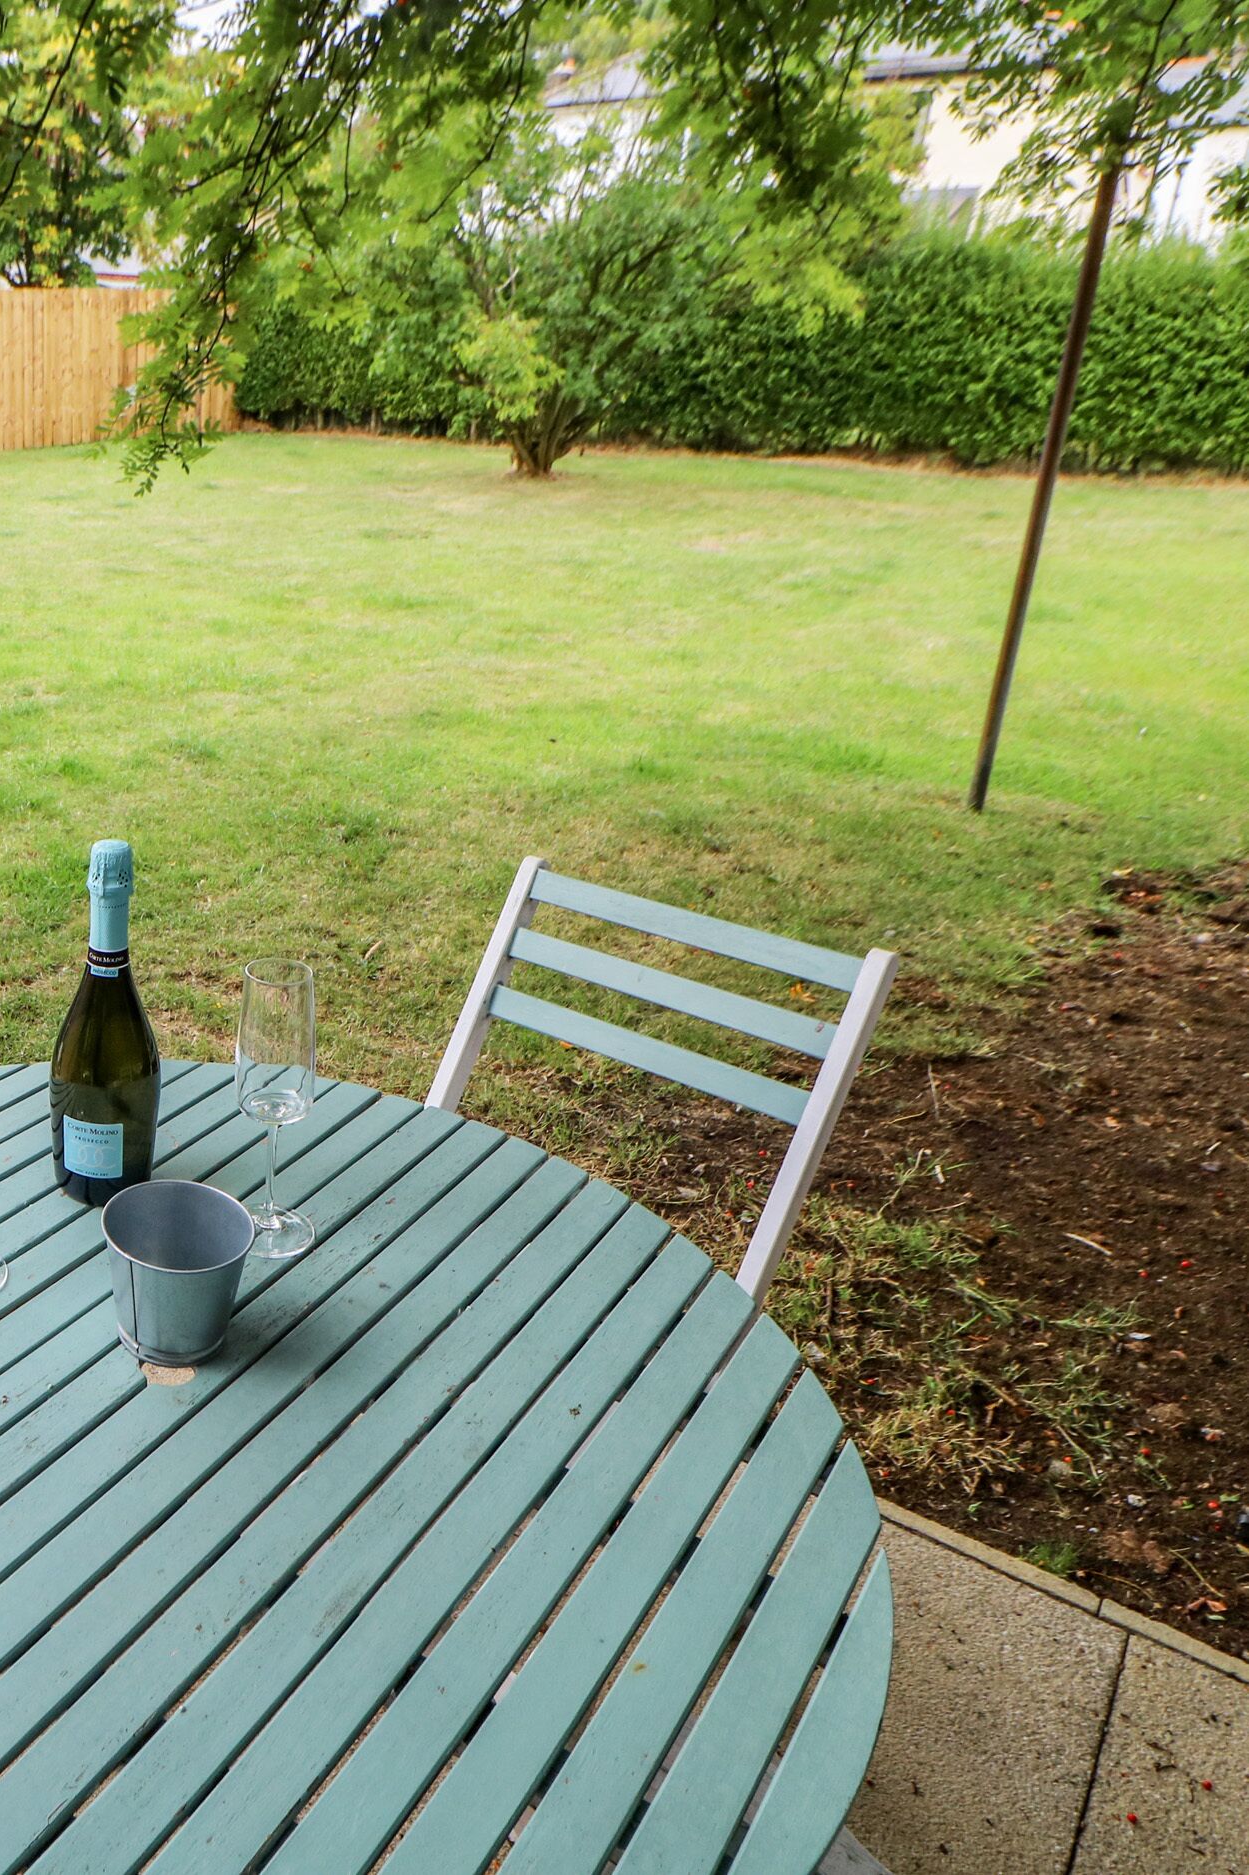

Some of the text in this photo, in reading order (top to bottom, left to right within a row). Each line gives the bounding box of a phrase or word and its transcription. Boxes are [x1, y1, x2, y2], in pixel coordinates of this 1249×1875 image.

[67, 1121, 118, 1136] CORTE MOLINO
[74, 1135, 109, 1144] PROSECCO
